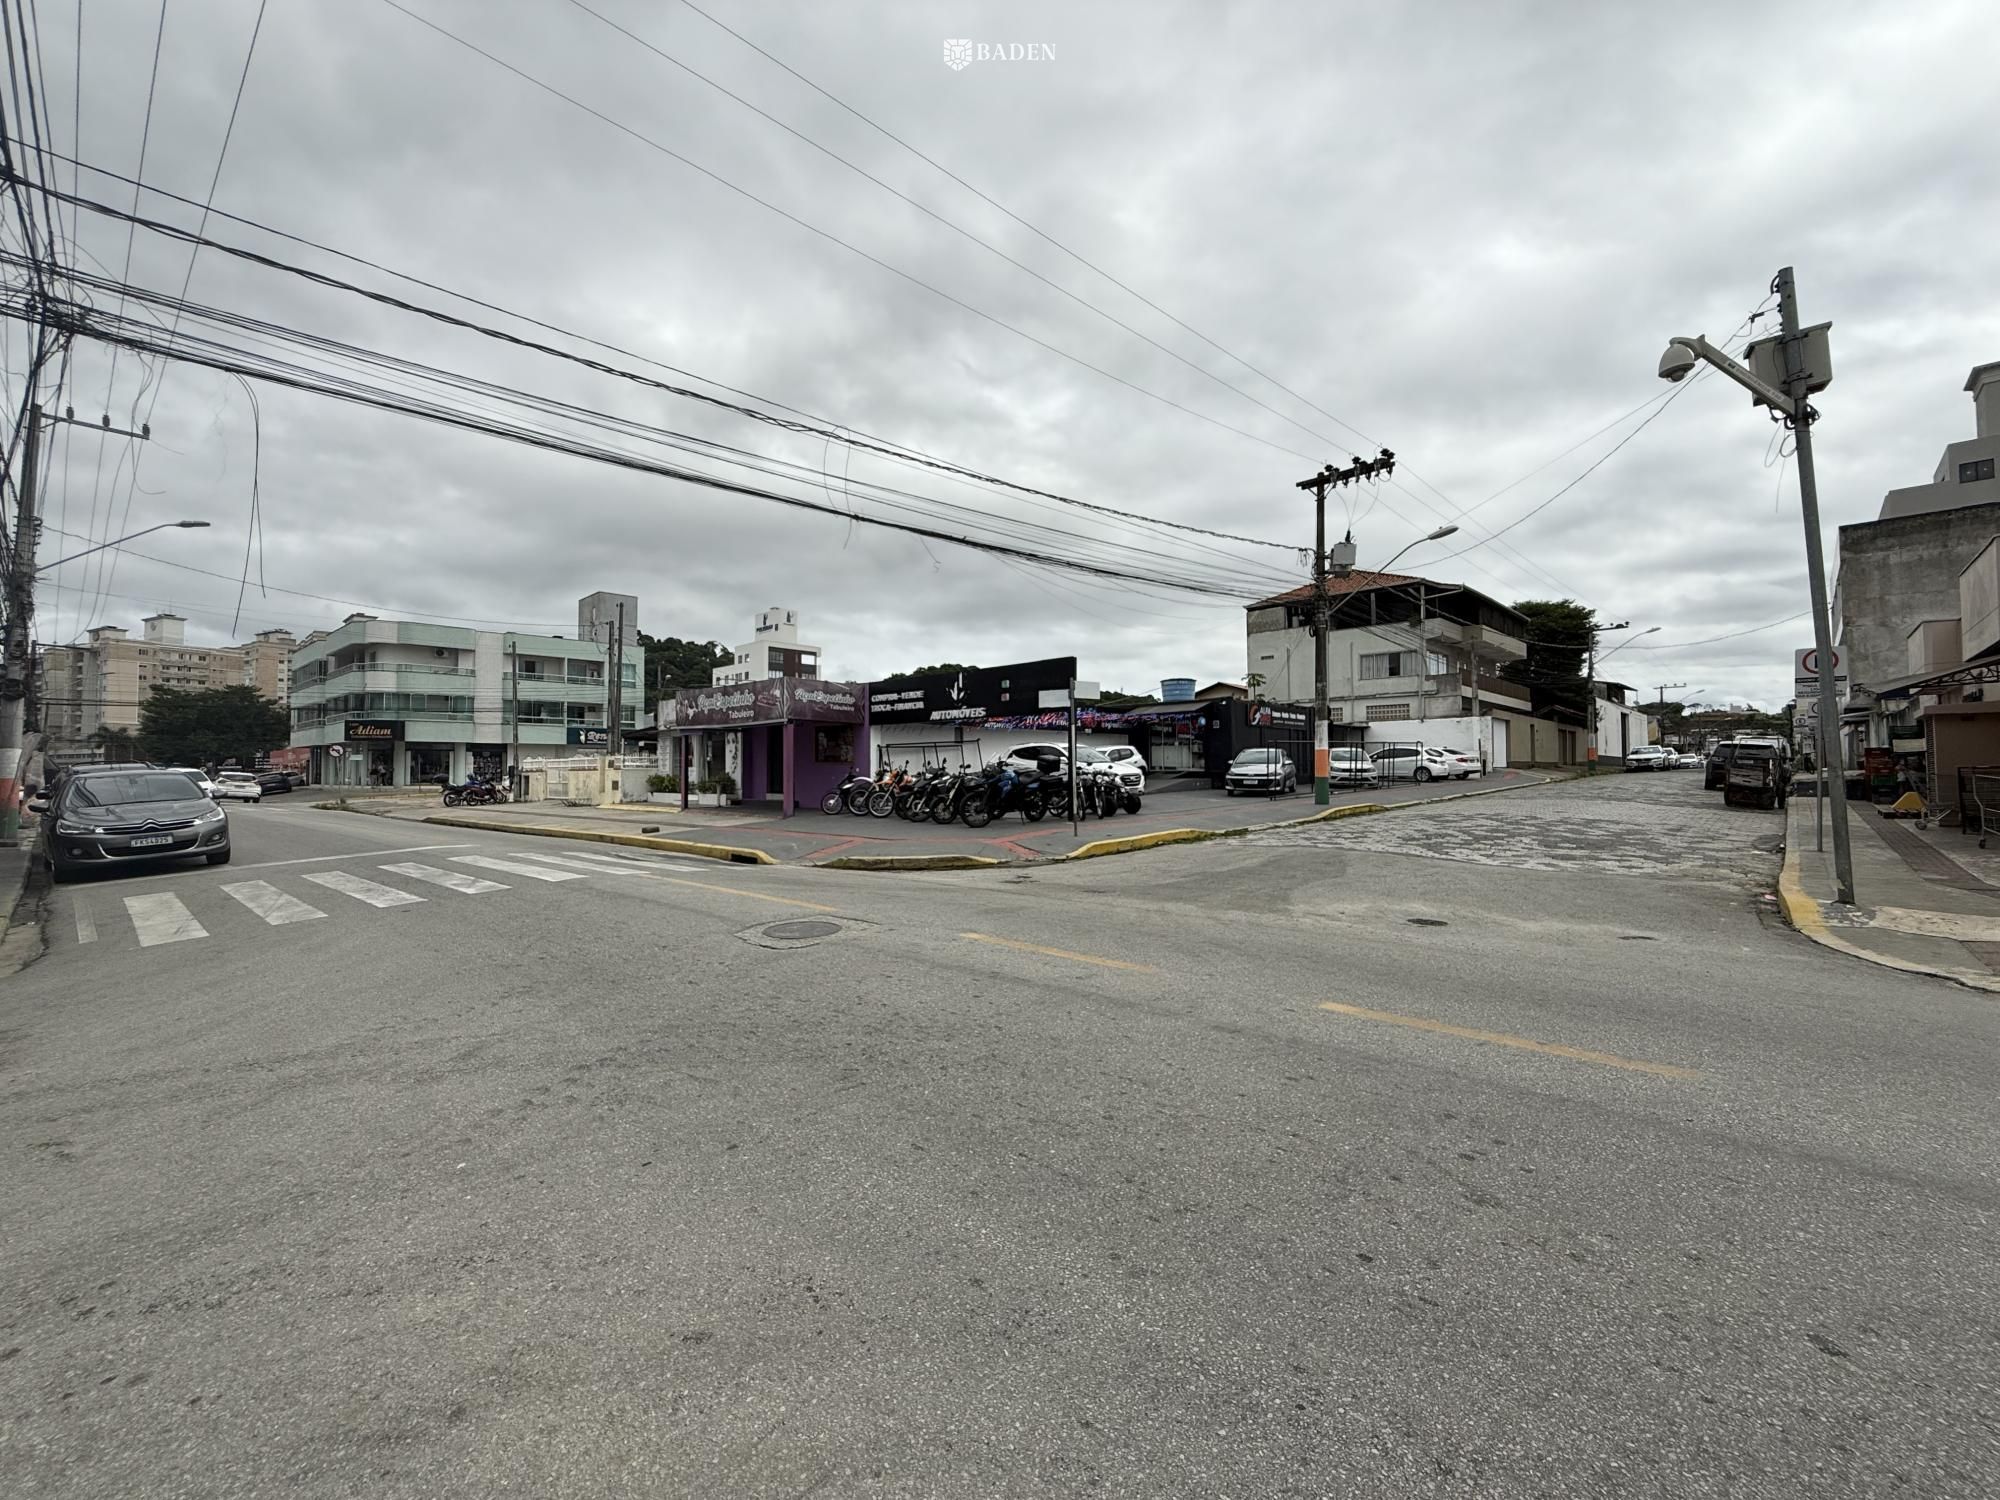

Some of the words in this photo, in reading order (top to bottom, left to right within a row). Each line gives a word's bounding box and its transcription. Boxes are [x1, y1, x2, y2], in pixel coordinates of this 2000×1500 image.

[829, 703, 855, 712] Tabuleiro
[728, 709, 755, 719] Tabuleiro
[930, 706, 987, 720] AUTOMÓVEIS
